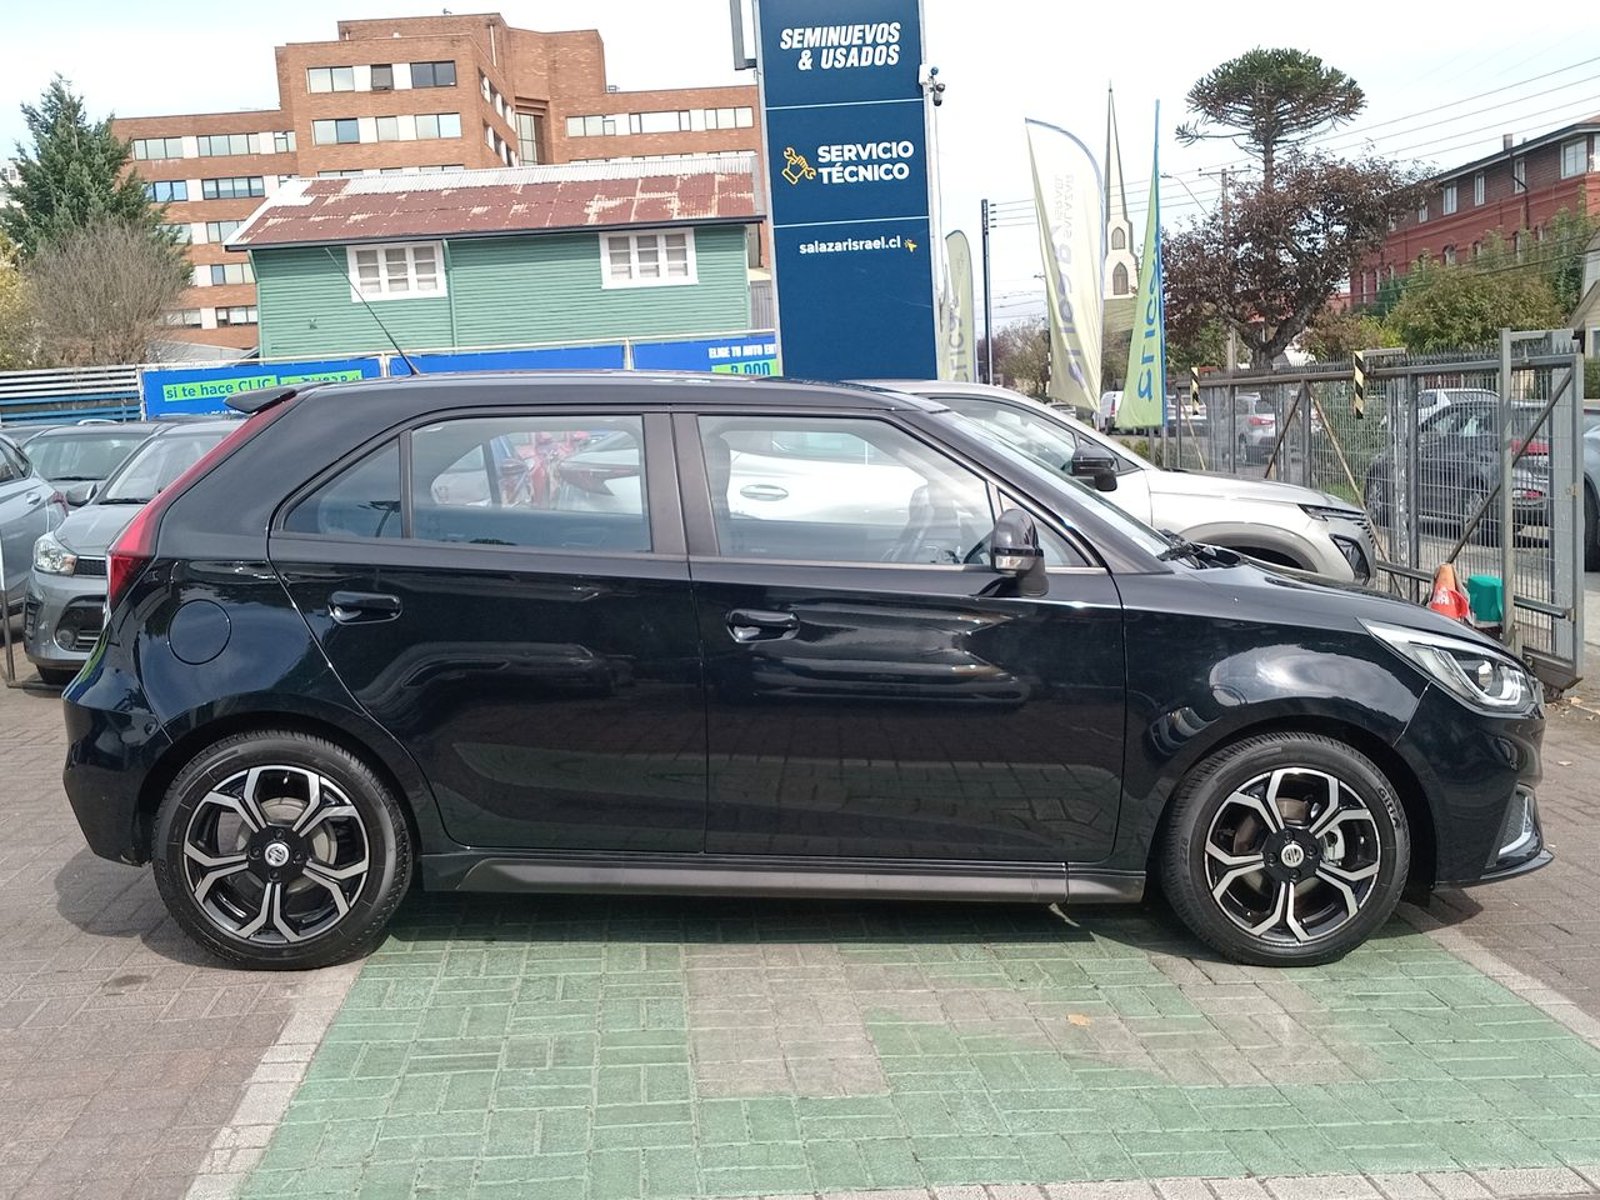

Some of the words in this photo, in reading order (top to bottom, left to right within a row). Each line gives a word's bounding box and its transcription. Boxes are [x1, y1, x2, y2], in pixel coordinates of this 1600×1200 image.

[780, 22, 901, 50] SEMINUEVOS
[798, 50, 812, 71] &
[820, 45, 900, 69] USADOS
[817, 141, 914, 163] SERVICIO
[818, 163, 910, 184] TÉCNICO
[799, 235, 901, 254] salazarisrael.cl
[166, 387, 177, 399] si
[182, 386, 196, 397] te
[200, 384, 234, 396] hace
